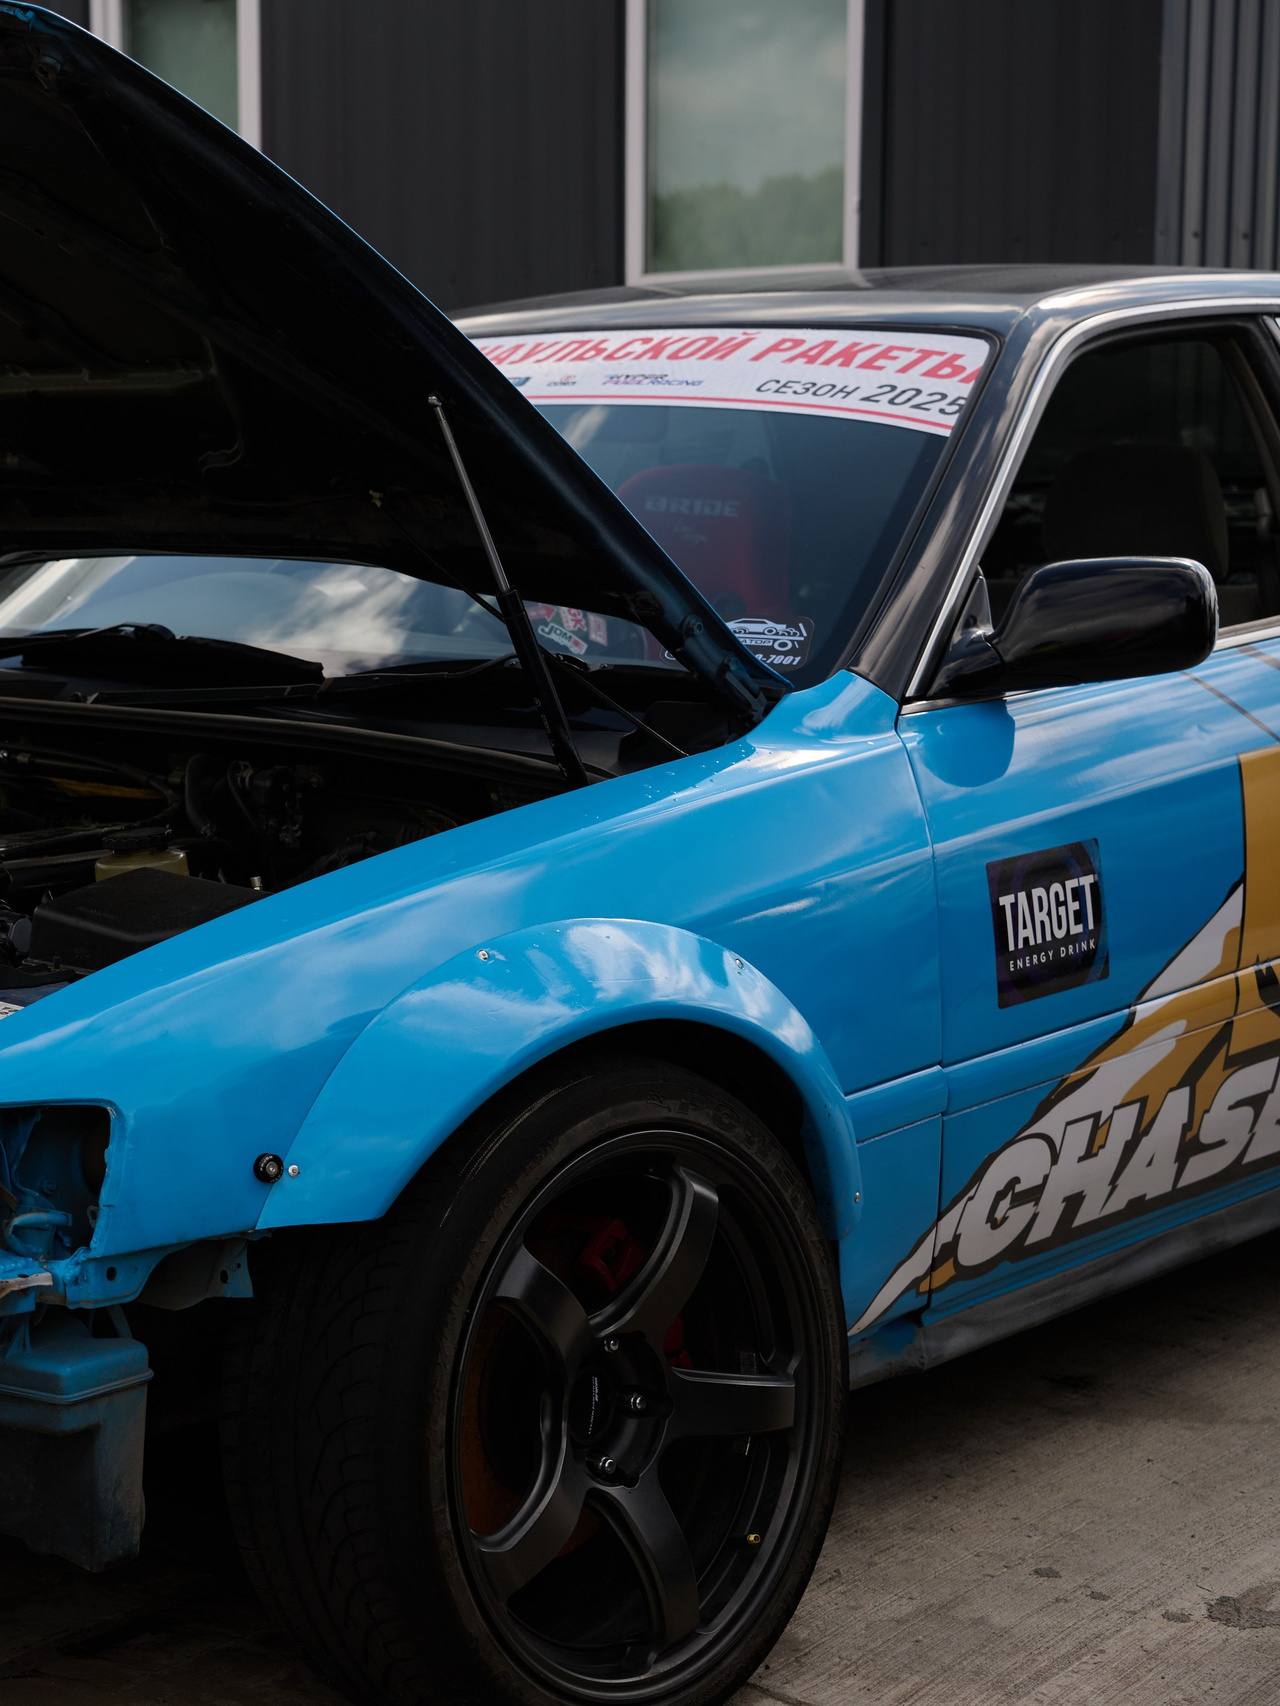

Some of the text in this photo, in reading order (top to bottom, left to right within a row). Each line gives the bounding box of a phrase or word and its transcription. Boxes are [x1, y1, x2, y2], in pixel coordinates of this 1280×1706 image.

[756, 379, 968, 416] СЕЗОН 2025
[645, 496, 740, 518] BRIDE
[999, 874, 1095, 952] TARGET
[1009, 938, 1096, 972] ENERGY DRINK
